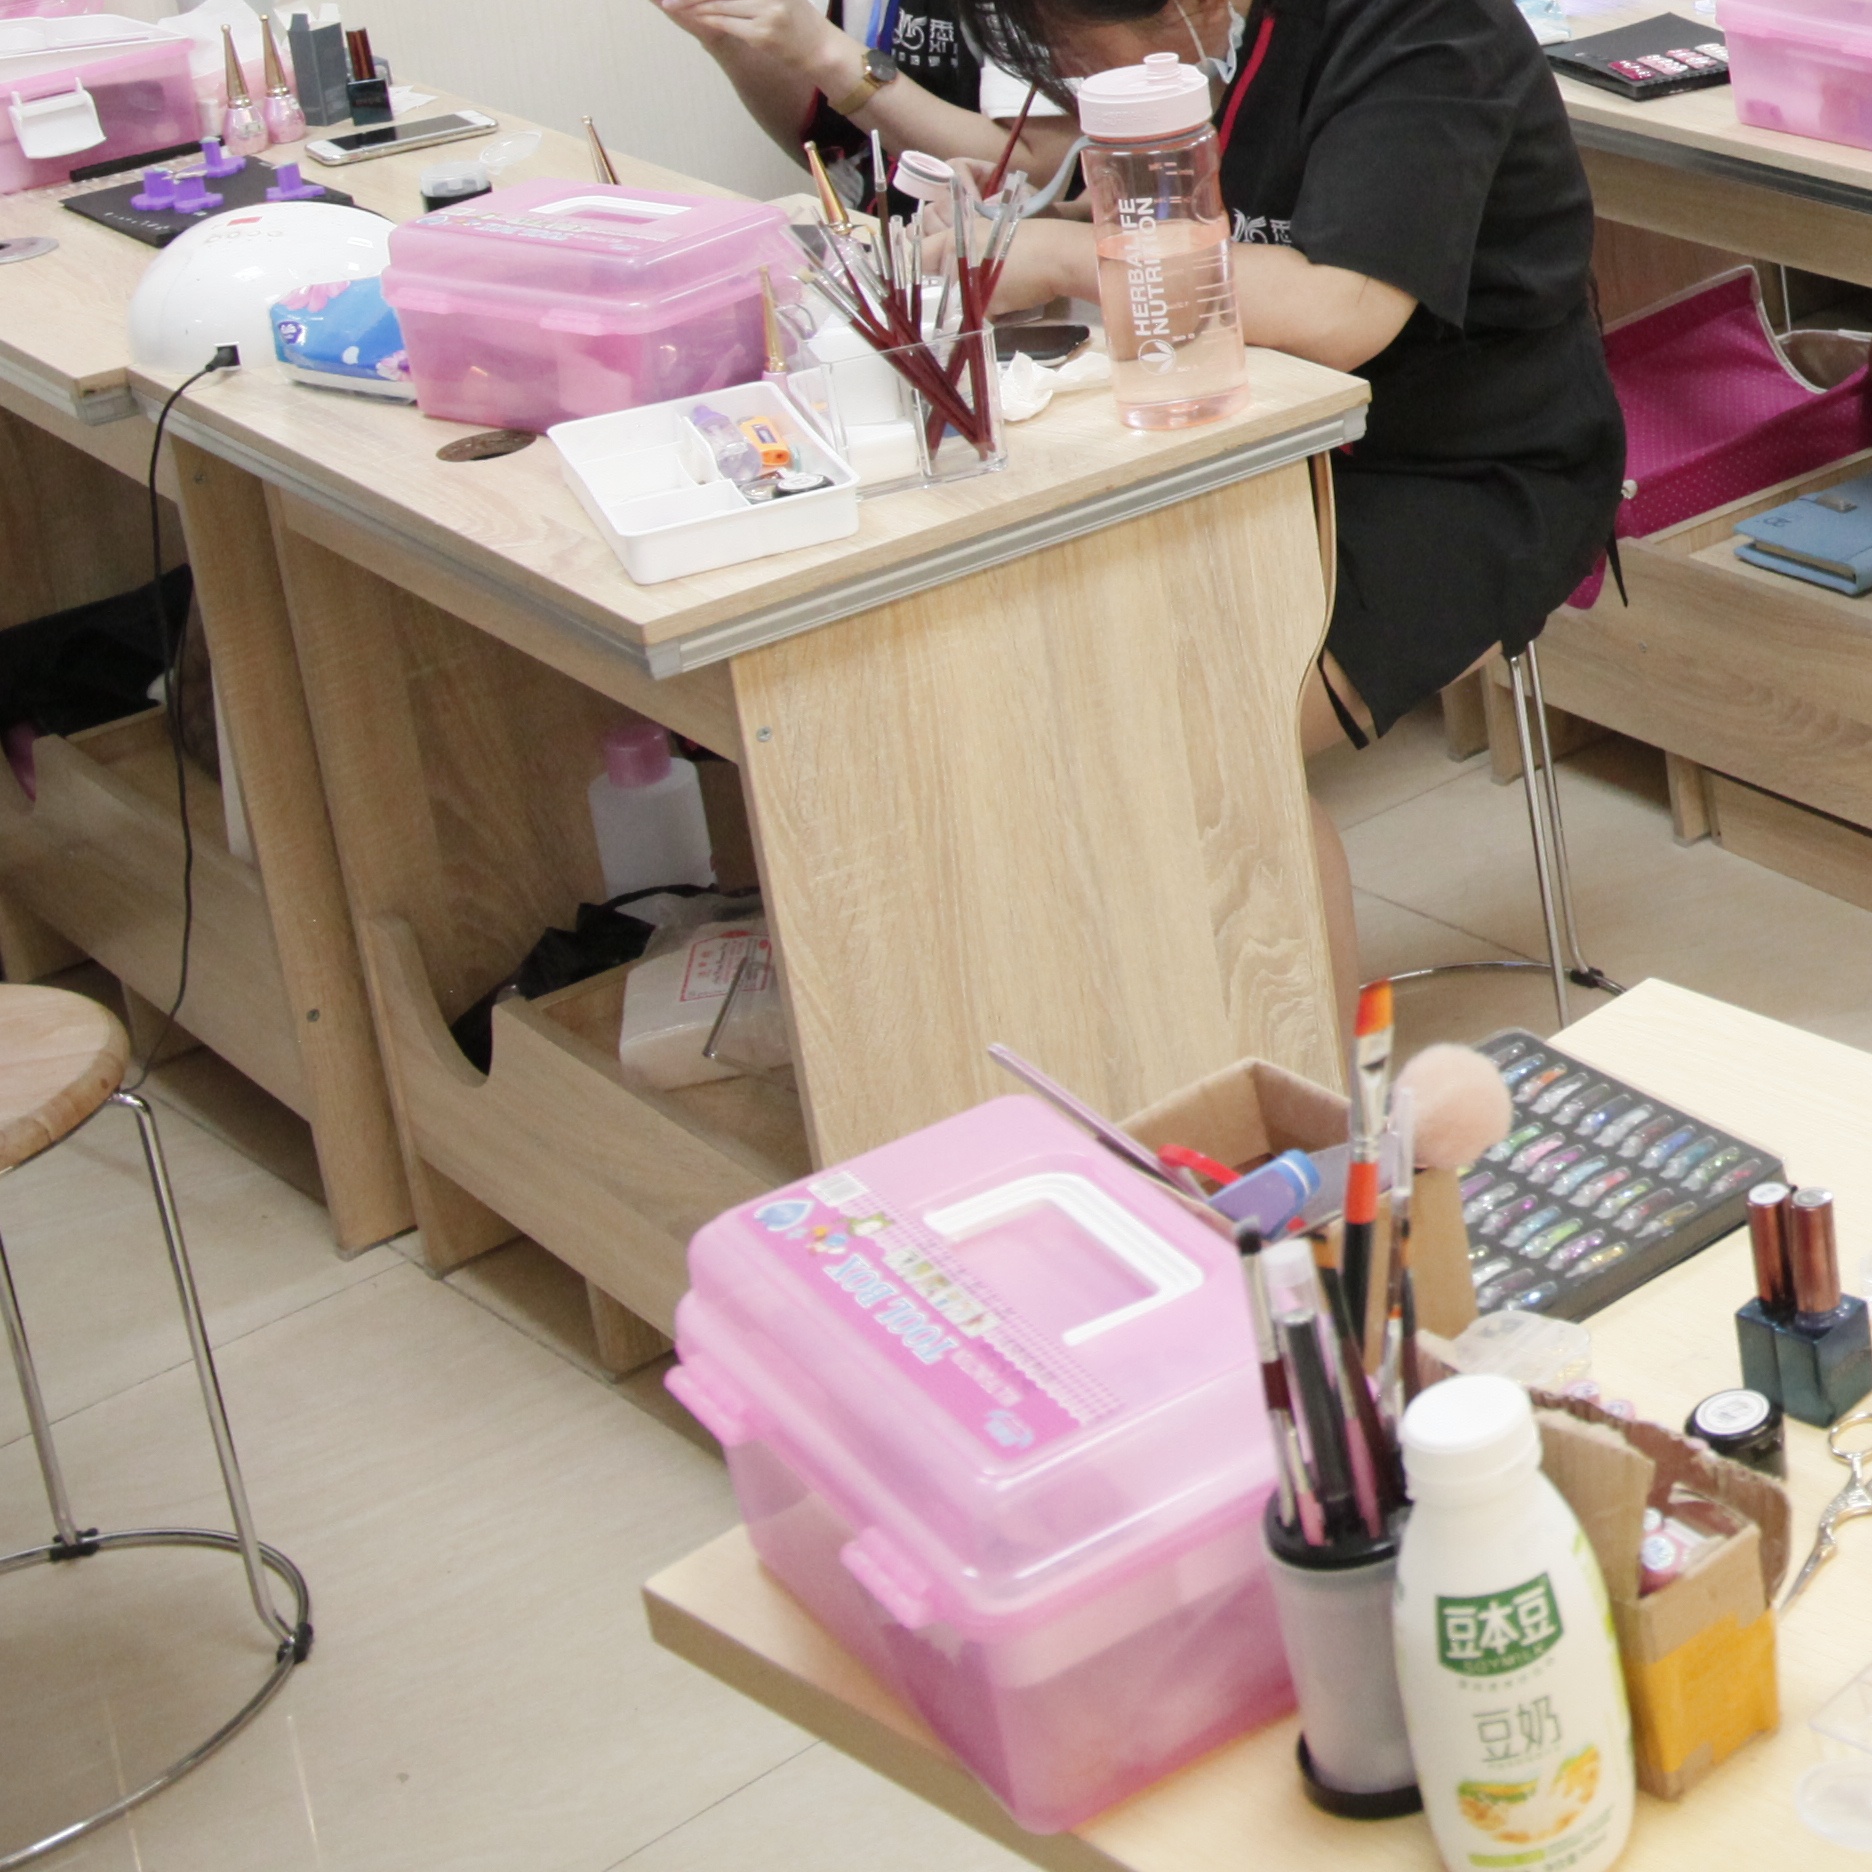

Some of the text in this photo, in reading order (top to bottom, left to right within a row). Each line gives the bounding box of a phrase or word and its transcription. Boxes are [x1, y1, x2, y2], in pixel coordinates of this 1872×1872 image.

[1118, 198, 1151, 336] HERBALIFE
[1136, 197, 1171, 336] NUTRIION
[822, 1253, 960, 1365] TOOL BOX
[1443, 1586, 1557, 1660] 豆本豆
[1472, 1695, 1562, 1763] 豆奶
